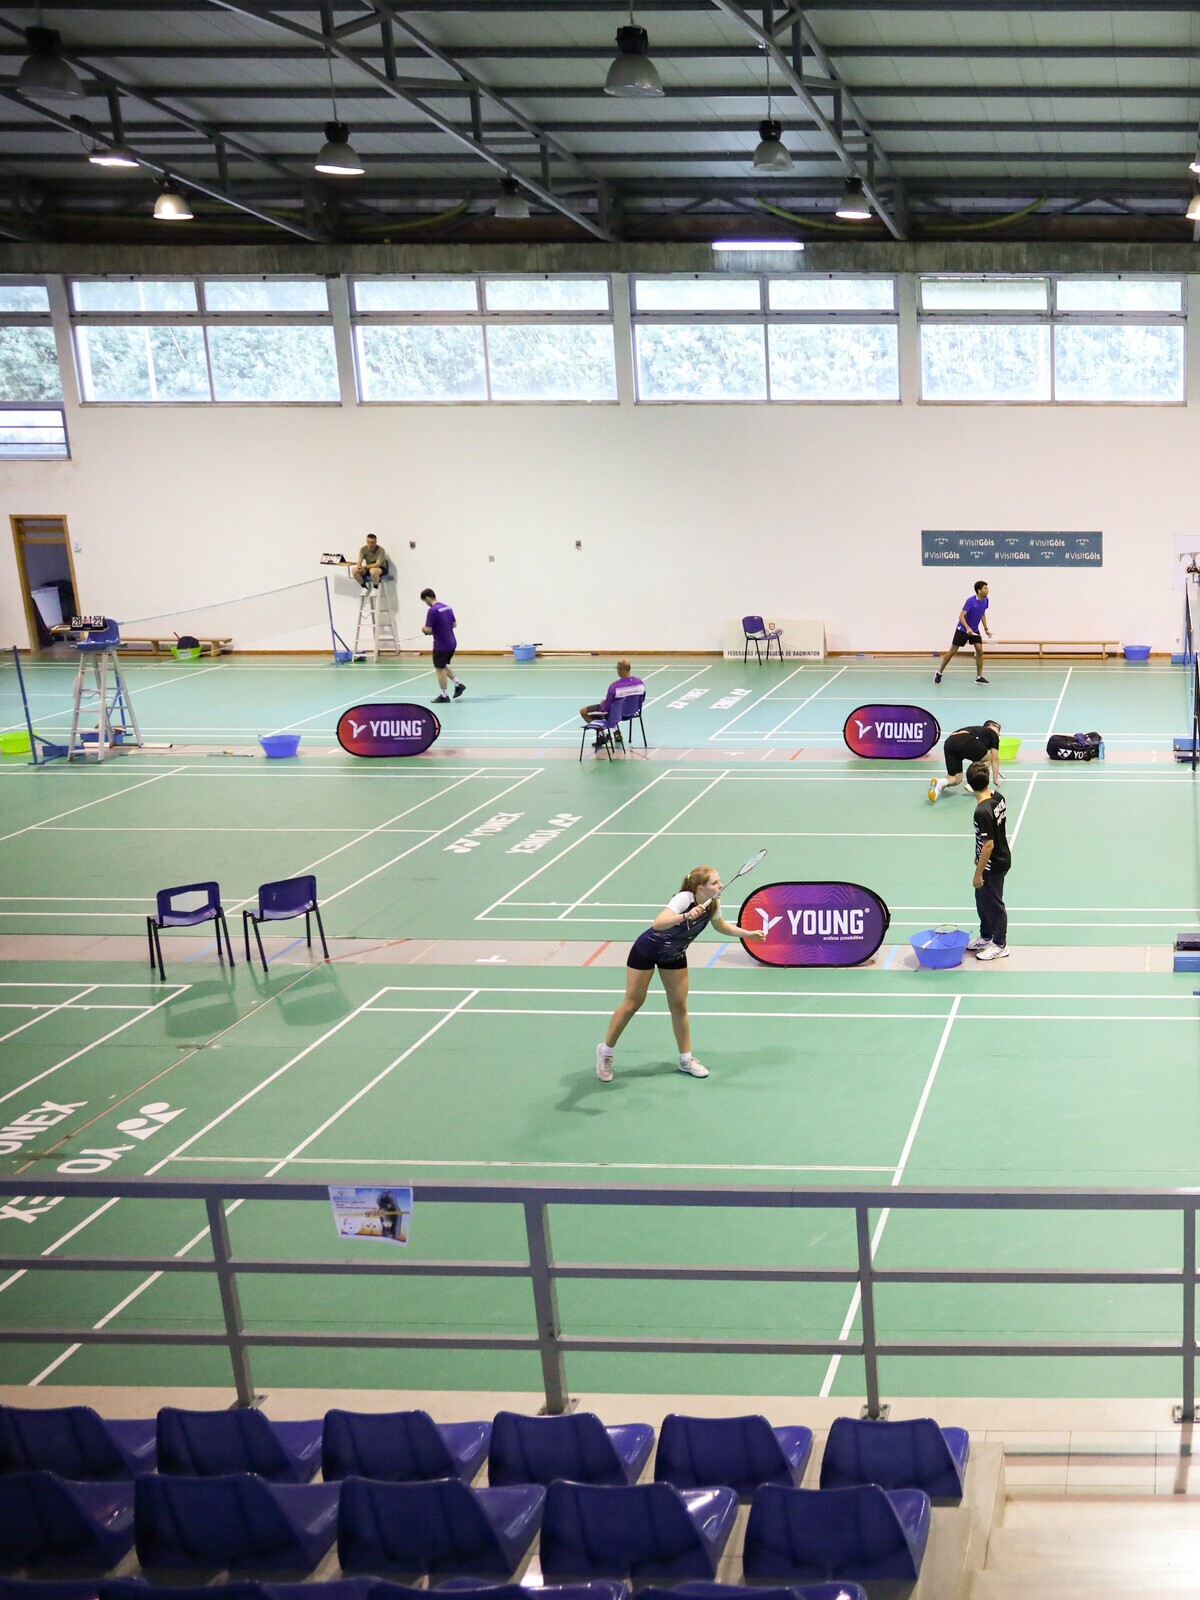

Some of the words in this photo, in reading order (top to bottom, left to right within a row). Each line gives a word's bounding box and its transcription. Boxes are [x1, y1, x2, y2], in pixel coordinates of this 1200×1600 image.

[1065, 552, 1100, 560] #VisitGóis
[464, 812, 526, 838] YONEX
[505, 828, 566, 854] YONEX
